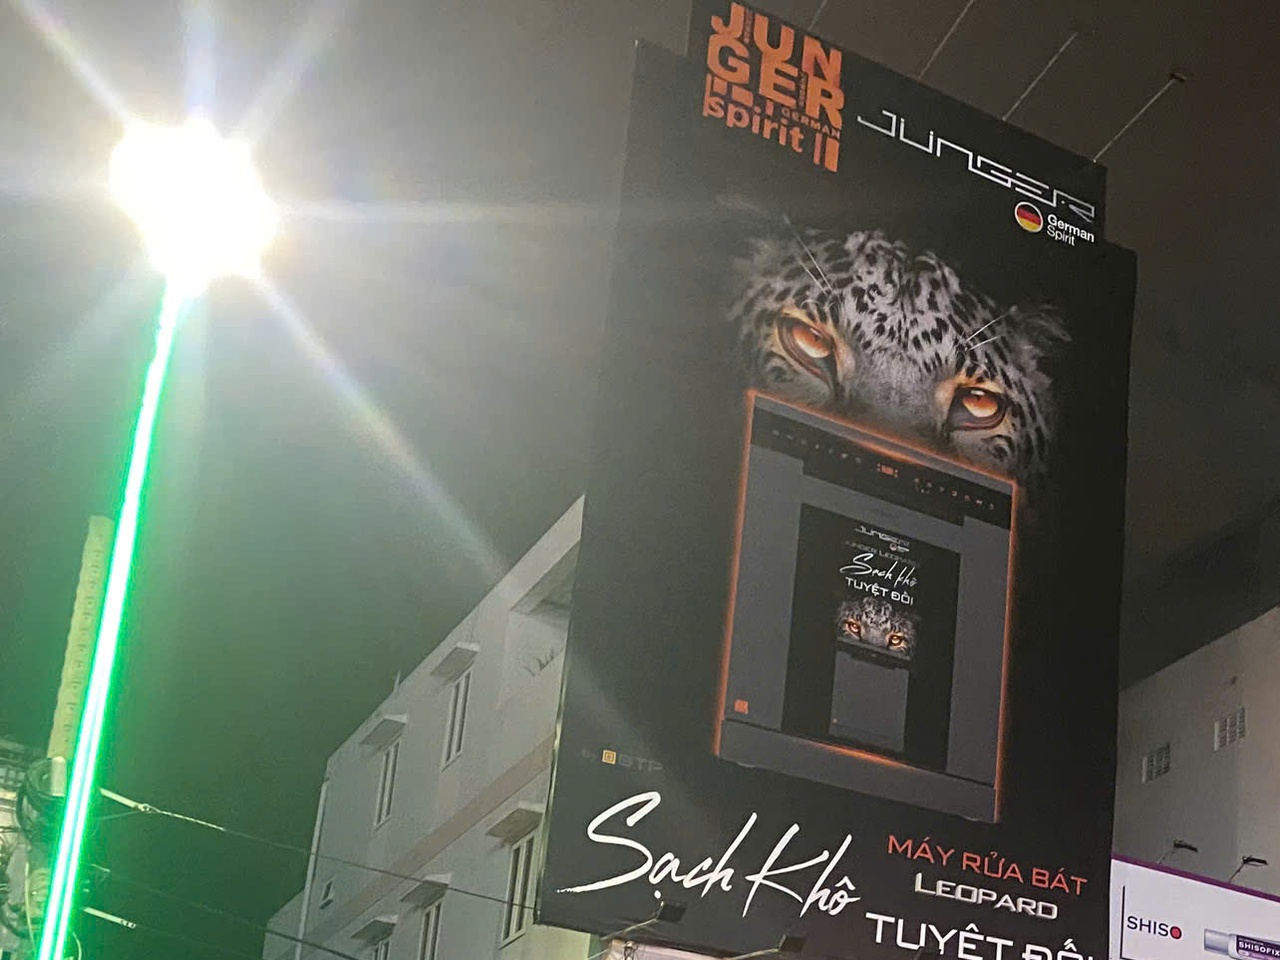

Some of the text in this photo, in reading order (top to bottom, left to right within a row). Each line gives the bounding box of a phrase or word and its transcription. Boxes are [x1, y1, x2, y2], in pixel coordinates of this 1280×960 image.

[857, 110, 1095, 224] JUNGER
[1046, 214, 1095, 243] German
[1046, 226, 1076, 247] Spirit
[556, 791, 757, 901] Sạch
[887, 835, 1088, 897] MÁY RỬA BÁT
[914, 873, 1058, 921] LEOPARD
[1126, 915, 1183, 940] SHISO
[1238, 941, 1280, 957] SHISOFIX
